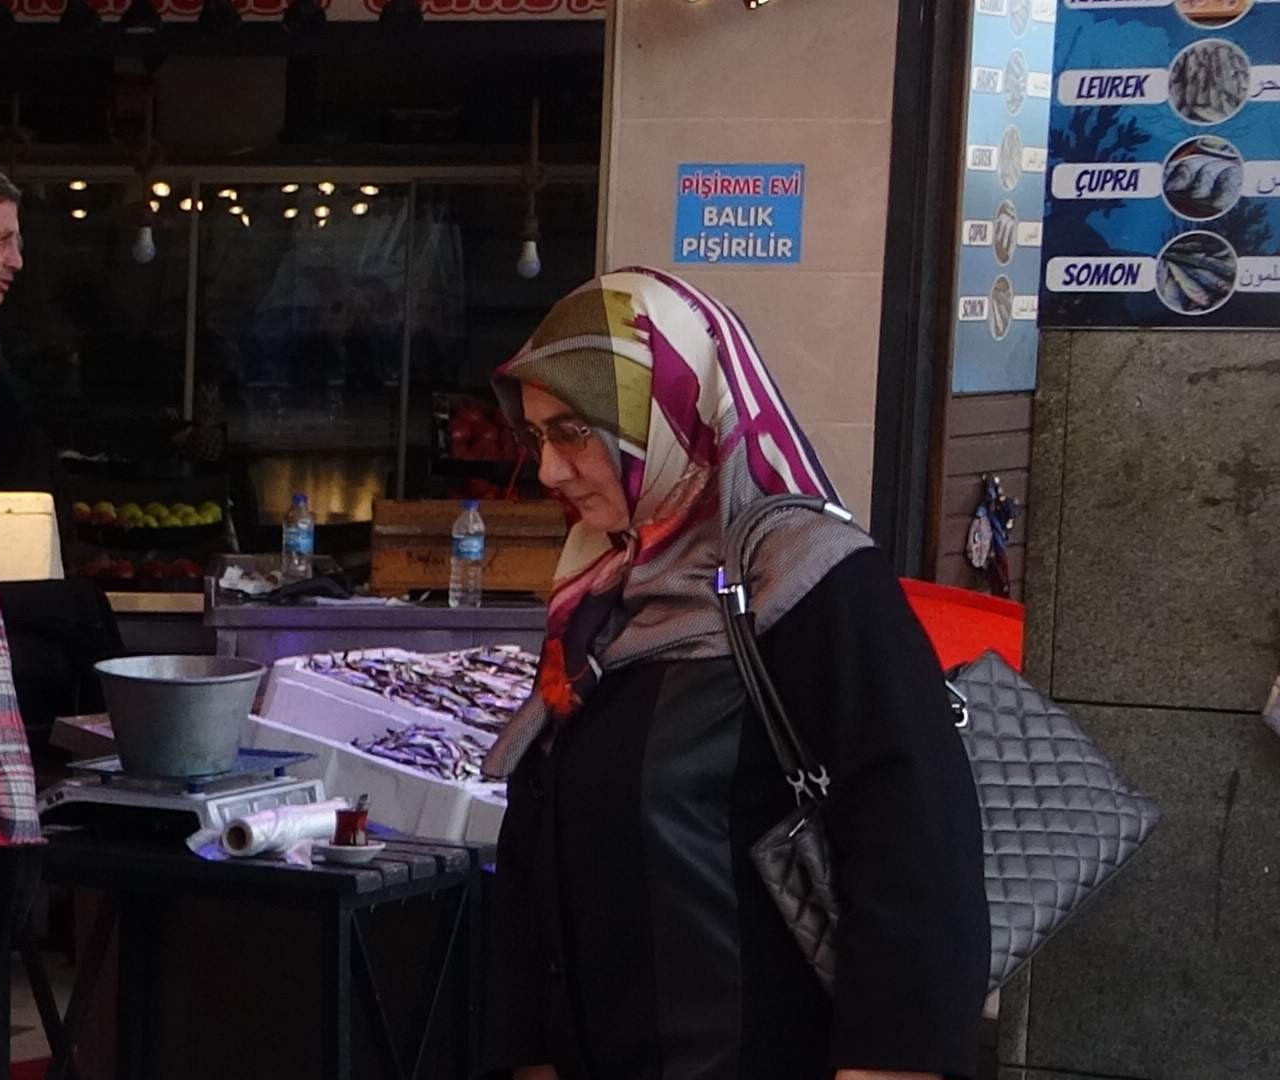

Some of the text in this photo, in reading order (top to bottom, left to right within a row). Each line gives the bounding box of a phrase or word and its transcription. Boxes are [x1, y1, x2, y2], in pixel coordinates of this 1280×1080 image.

[1077, 75, 1150, 99] LEVREK
[681, 171, 801, 199] PİŞİRME EVİ
[1075, 169, 1139, 197] ÇUPRA
[703, 205, 773, 227] BALIK
[682, 232, 792, 262] PİŞİRİLİR
[1062, 263, 1142, 286] SOMON
